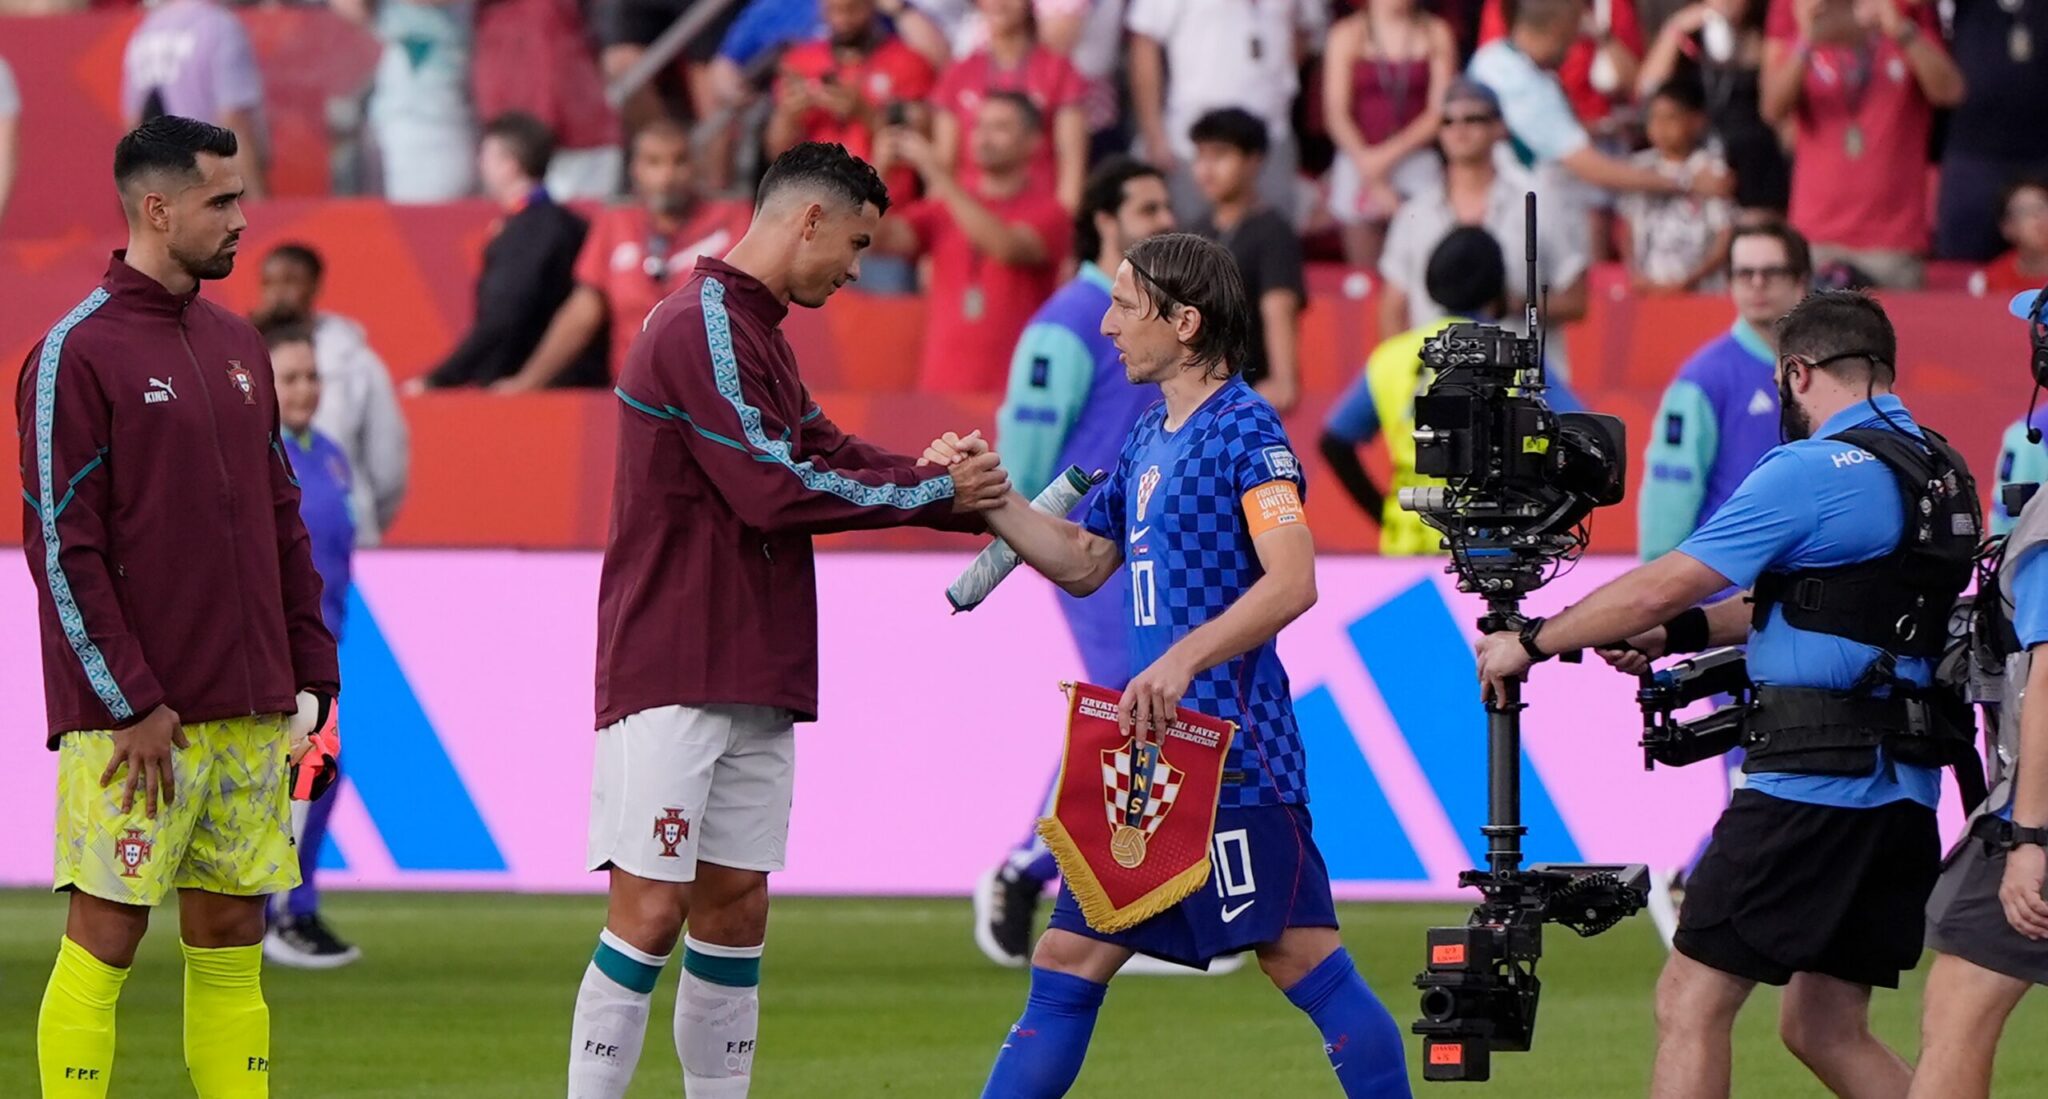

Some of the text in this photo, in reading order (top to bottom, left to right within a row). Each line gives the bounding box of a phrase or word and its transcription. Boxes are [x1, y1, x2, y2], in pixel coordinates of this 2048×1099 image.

[144, 390, 169, 404] KING
[1831, 449, 1876, 468] HOS
[1259, 493, 1299, 510] UNITES
[1131, 561, 1157, 627] 10
[1081, 697, 1119, 713] HRVATS
[1166, 727, 1219, 748] FEDERATION
[1189, 724, 1221, 740] SAVEZ
[584, 1040, 619, 1057] F.P.F.
[65, 1067, 100, 1080] F.P.F.
